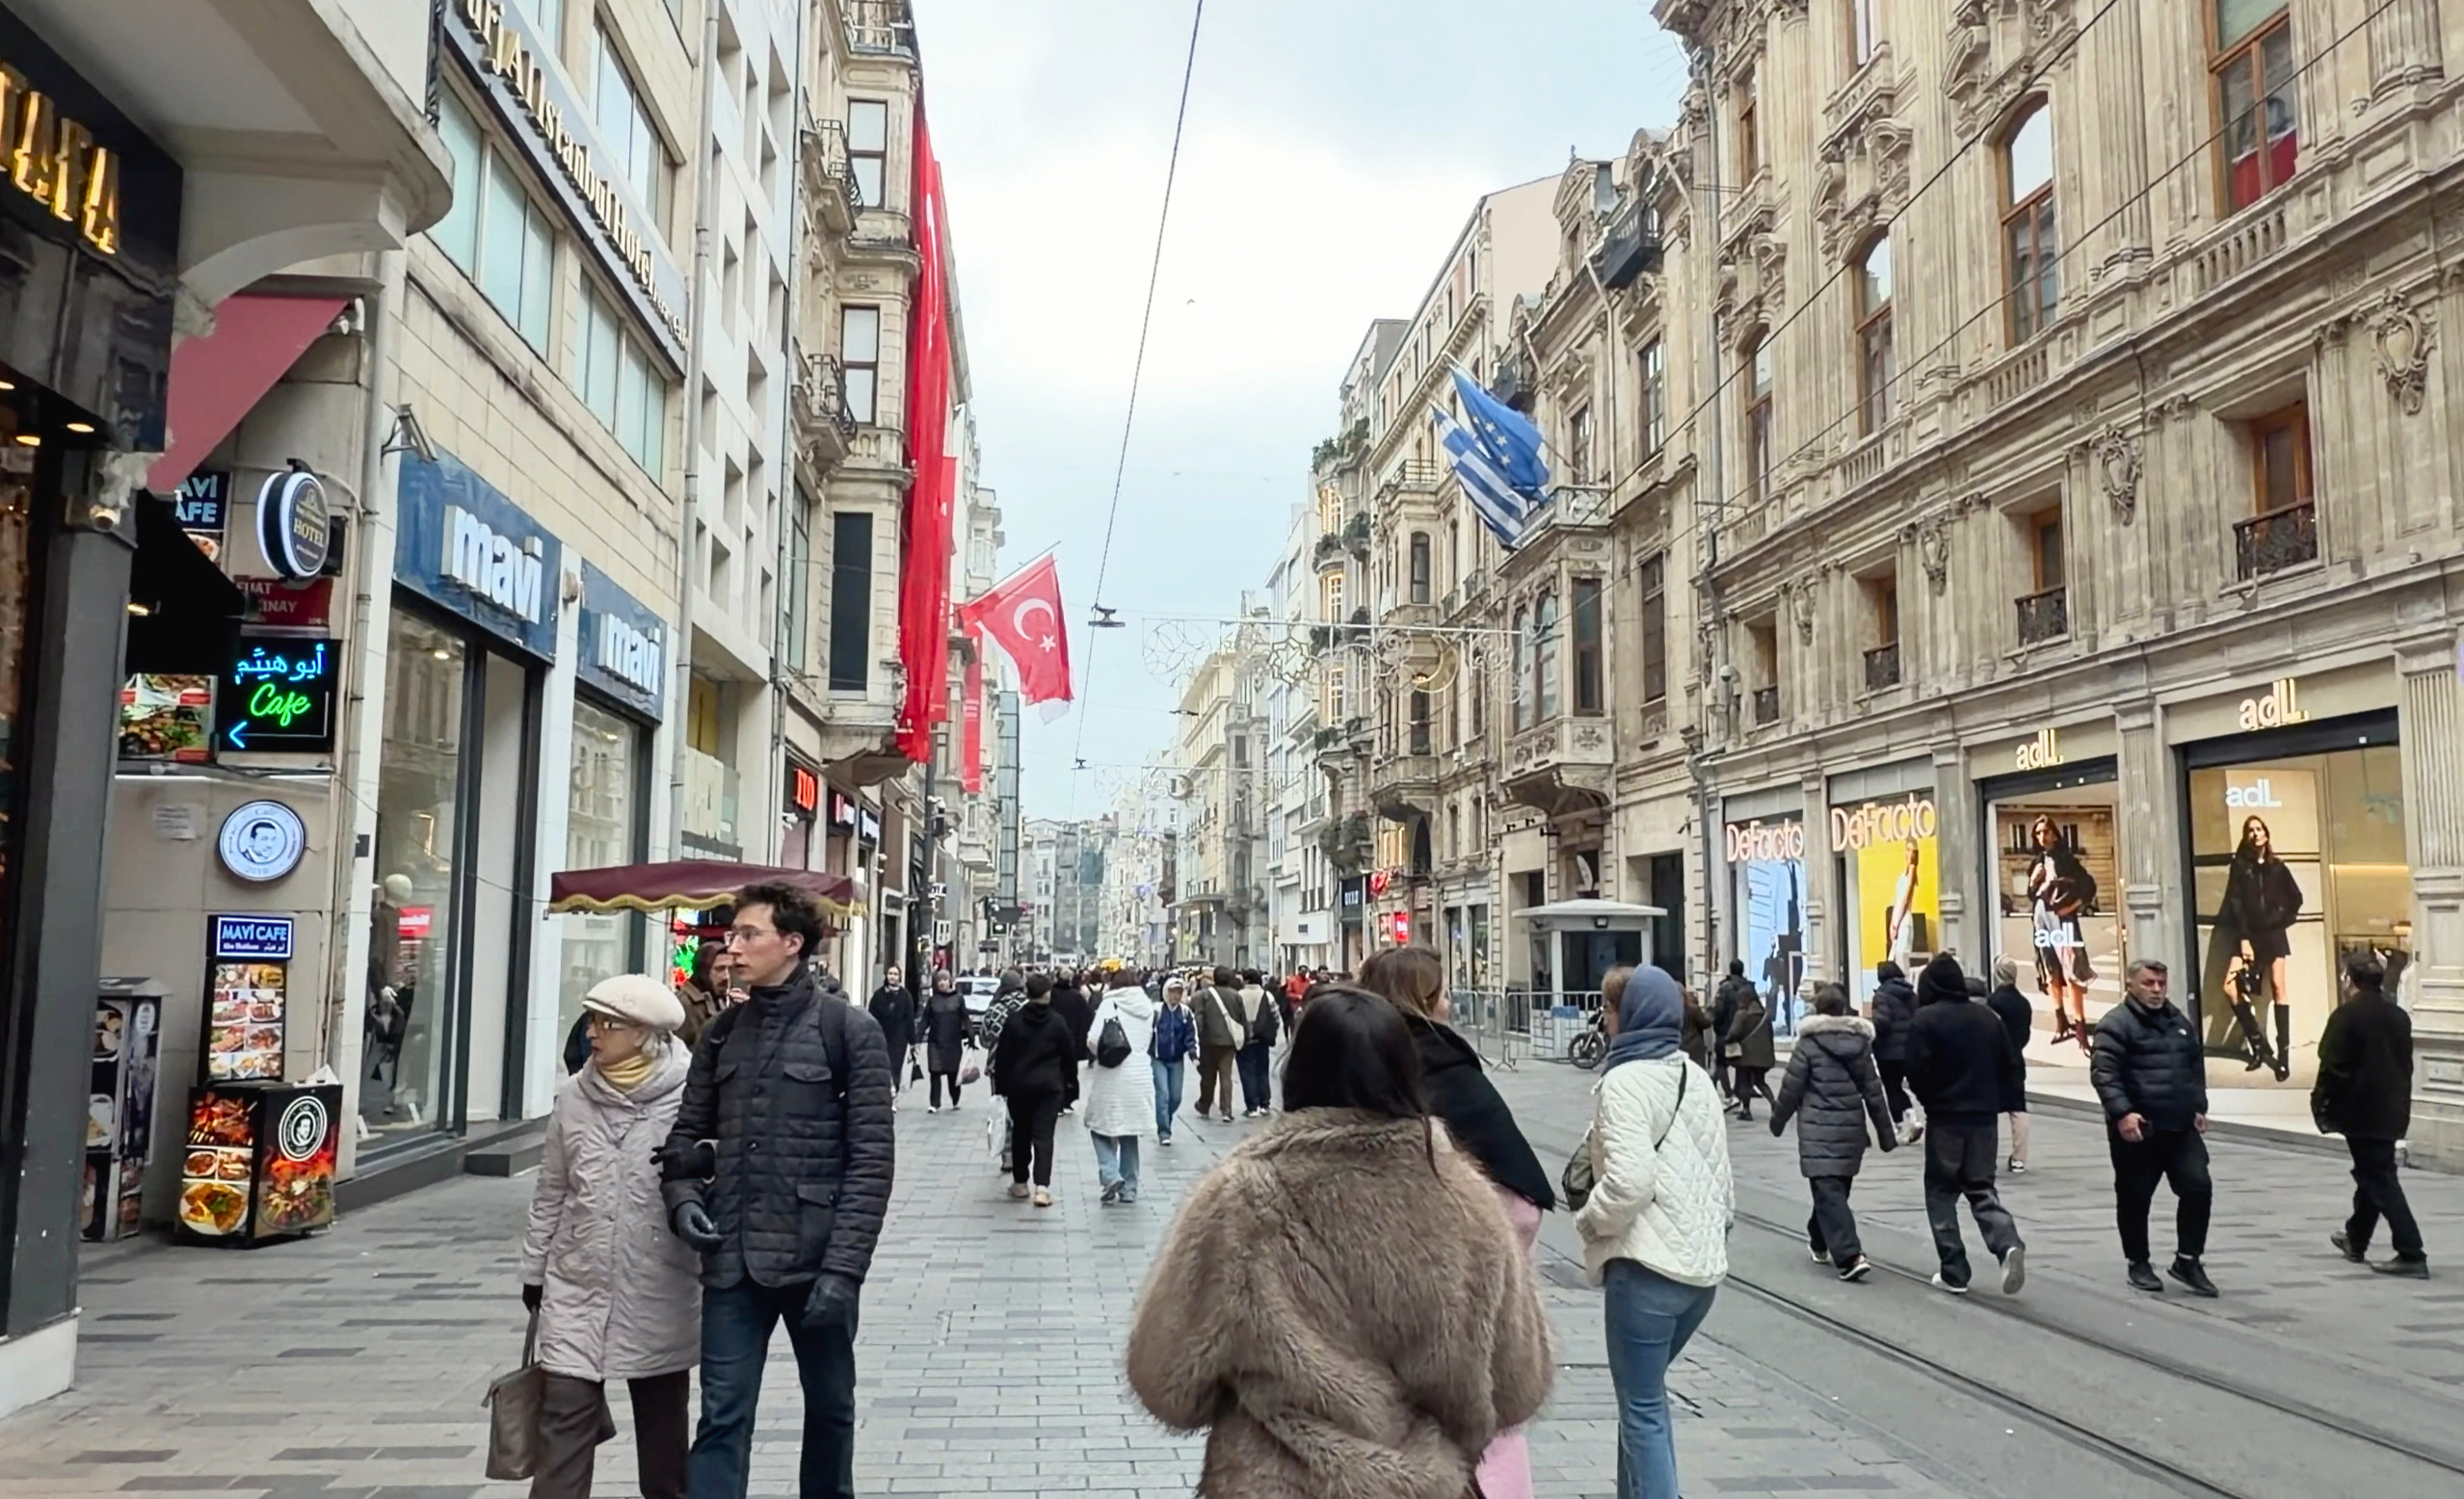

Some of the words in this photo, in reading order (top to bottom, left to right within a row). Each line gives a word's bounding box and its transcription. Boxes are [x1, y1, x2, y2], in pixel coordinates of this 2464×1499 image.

[613, 196, 655, 296] Hotel
[175, 502, 218, 522] AFE
[293, 517, 325, 548] HOTEL
[442, 505, 543, 625] mavi
[598, 612, 661, 696] mavi
[251, 683, 311, 727] Cafe
[1726, 817, 1805, 863] DeFacto
[1831, 792, 1936, 853] DeFacto
[255, 926, 287, 941] CAFE
